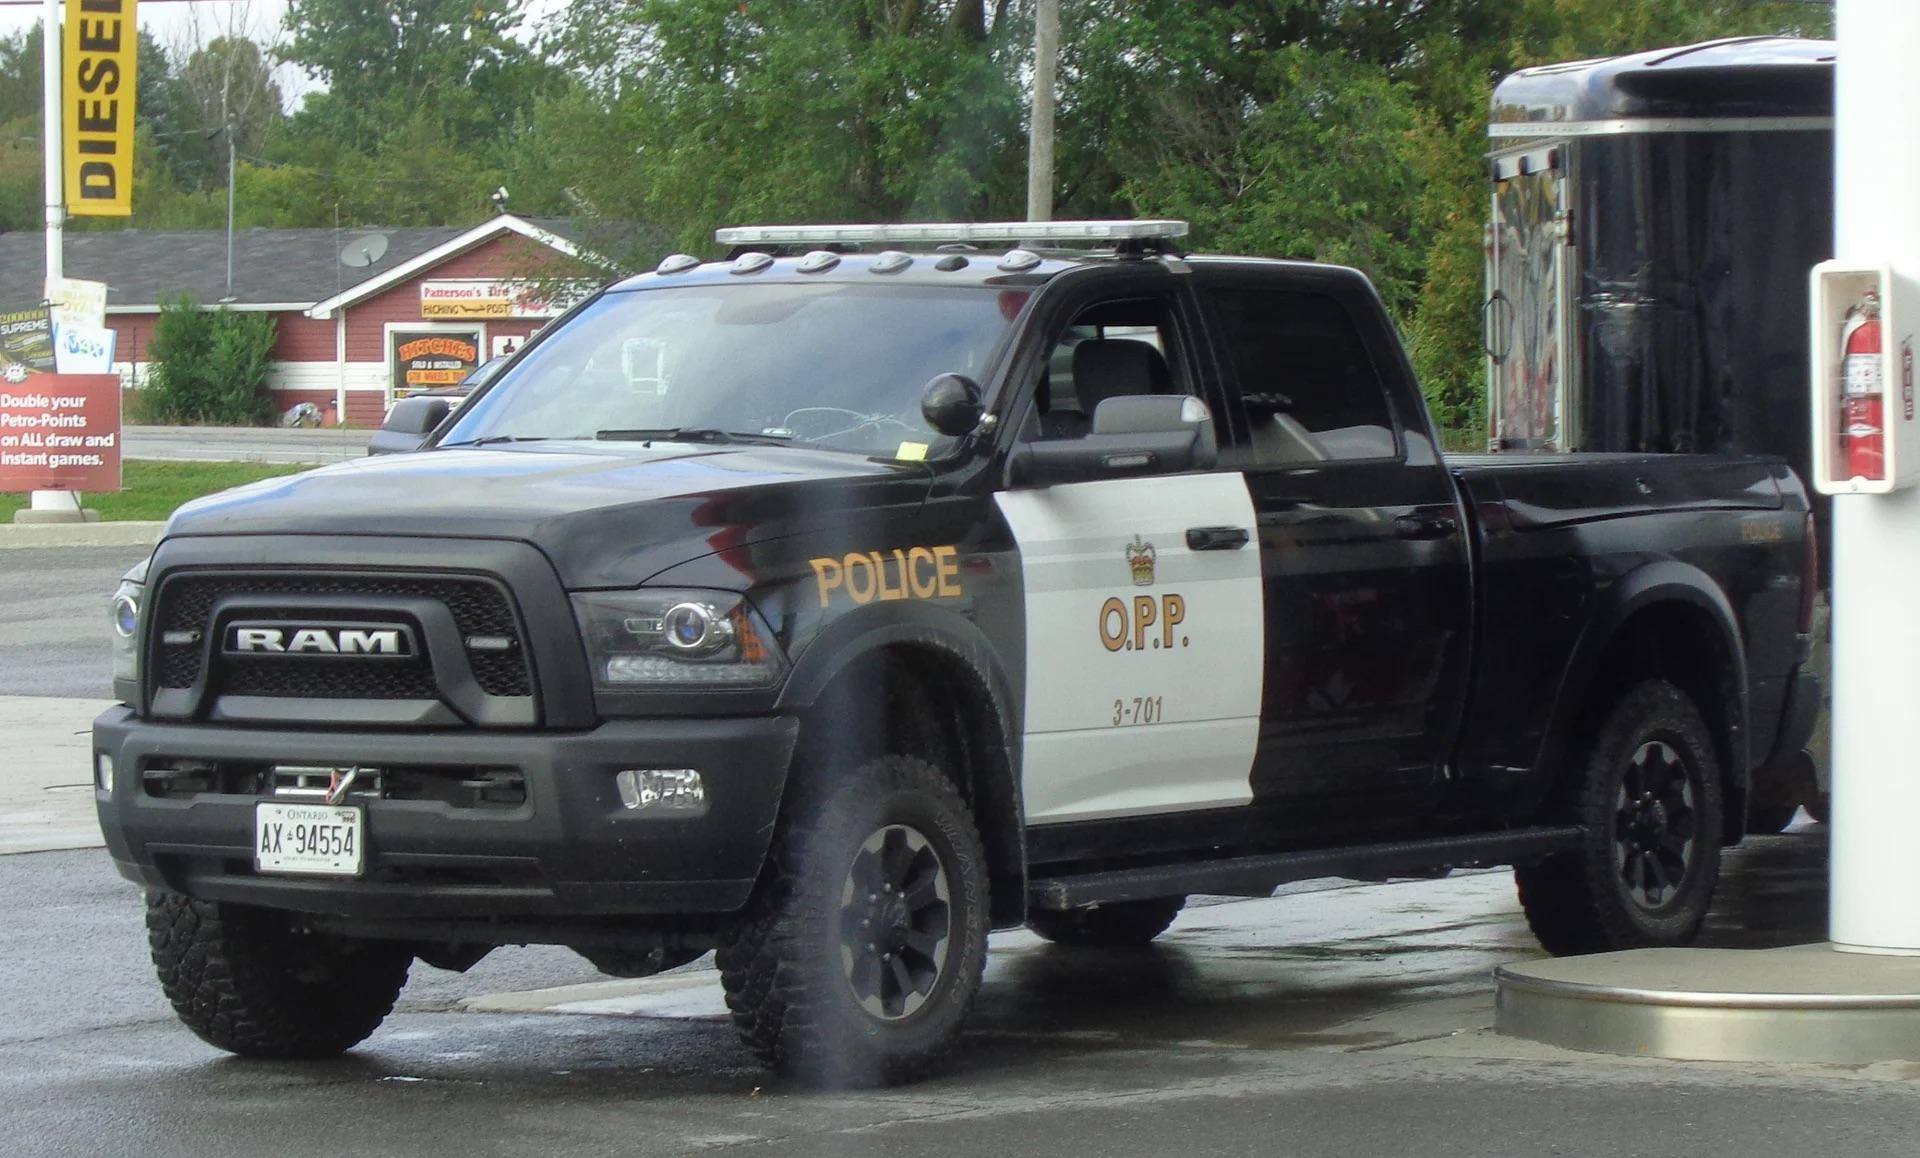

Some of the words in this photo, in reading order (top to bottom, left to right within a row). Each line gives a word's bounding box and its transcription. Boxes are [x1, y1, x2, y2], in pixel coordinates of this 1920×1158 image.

[424, 287, 481, 298] Patterson's
[0, 319, 48, 336] SUPREME
[0, 394, 49, 408] Double
[51, 396, 87, 411] your
[0, 413, 87, 427] Petro-Points
[1, 436, 19, 447] on
[20, 433, 44, 447] ALL
[45, 433, 83, 447] draw
[85, 433, 114, 447] and
[1, 451, 48, 465] instant
[49, 454, 104, 469] games.
[808, 545, 962, 609] POLICE
[1099, 593, 1189, 652] O.P.P.
[237, 628, 399, 654] RAM
[1113, 696, 1163, 727] 3-701
